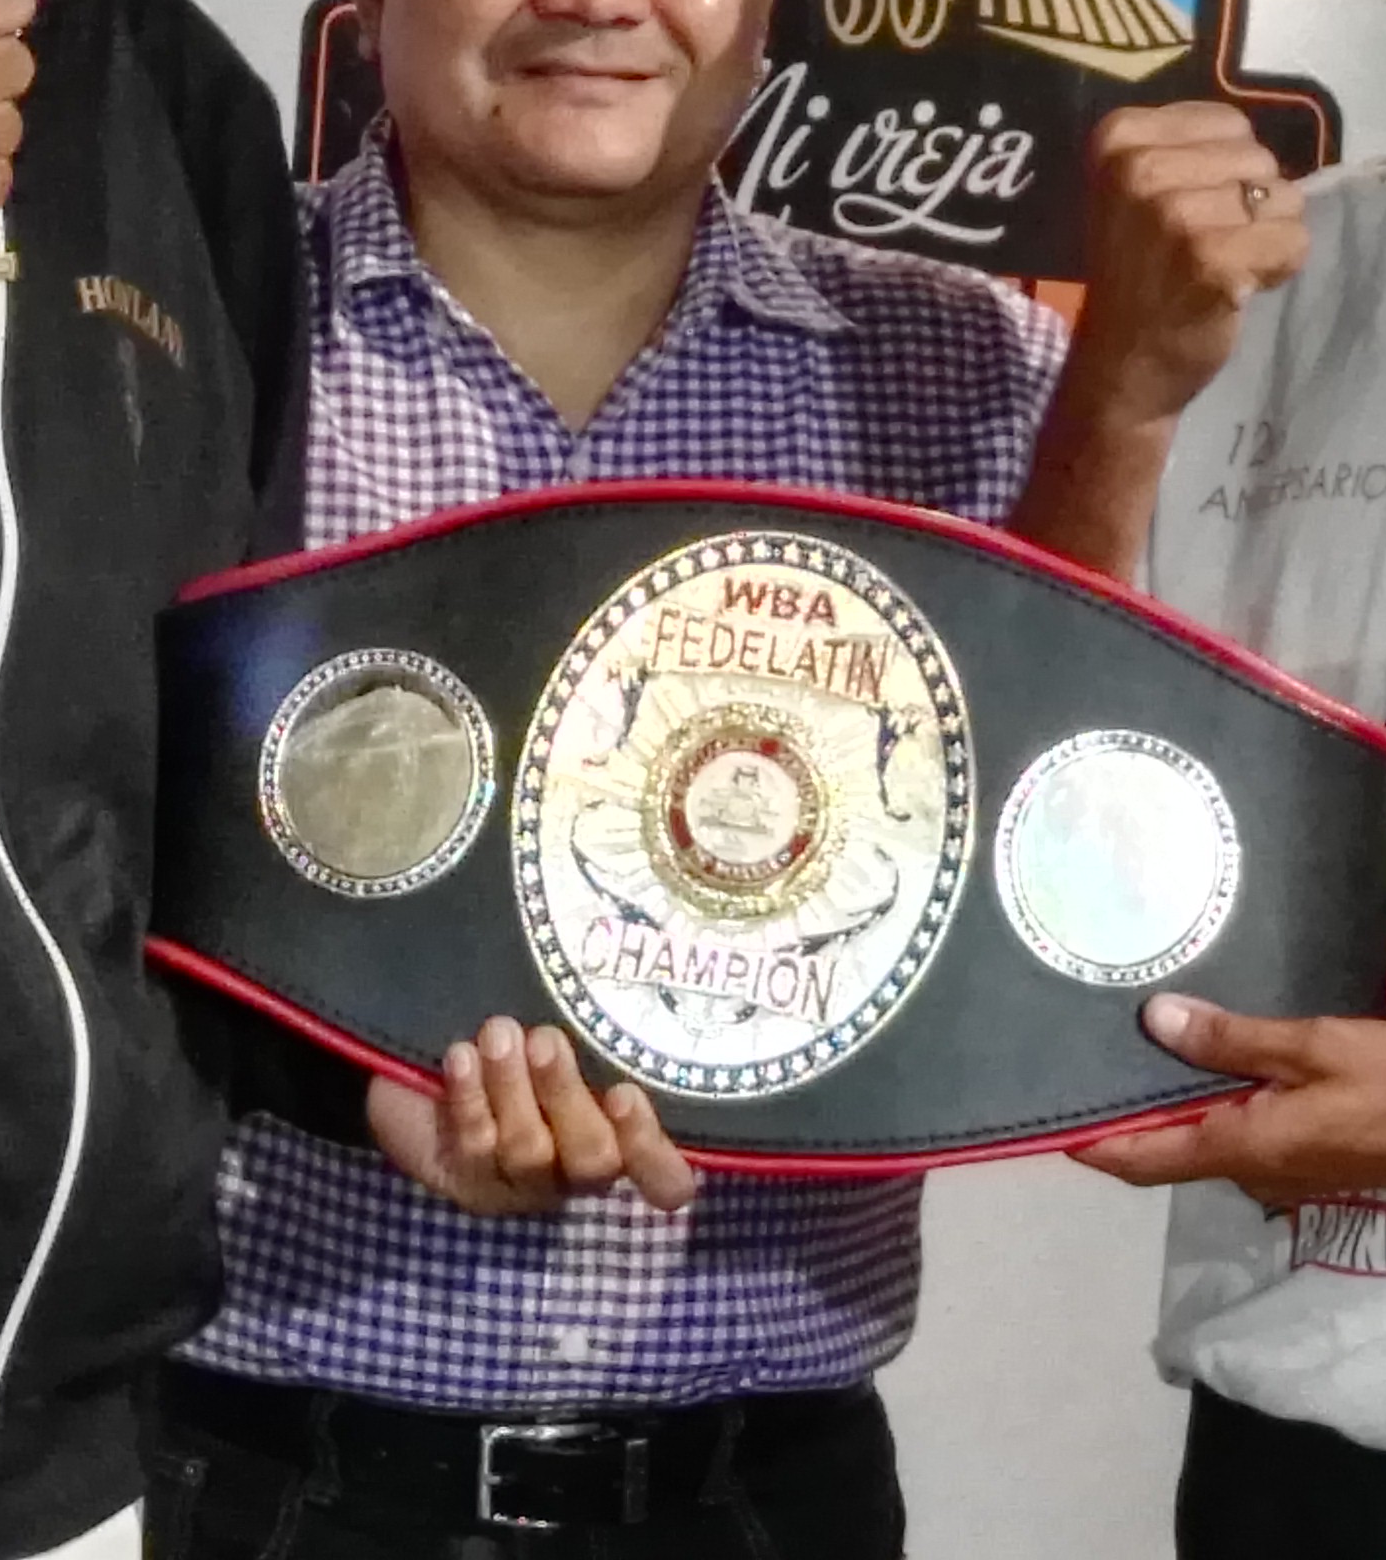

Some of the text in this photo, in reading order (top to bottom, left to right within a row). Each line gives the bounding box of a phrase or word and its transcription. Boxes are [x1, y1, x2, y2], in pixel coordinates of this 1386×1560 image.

[830, 100, 1035, 244] vieja
[724, 576, 836, 628] WBA
[650, 606, 891, 703] FEDELATIN
[581, 916, 838, 1023] CHAMPION
